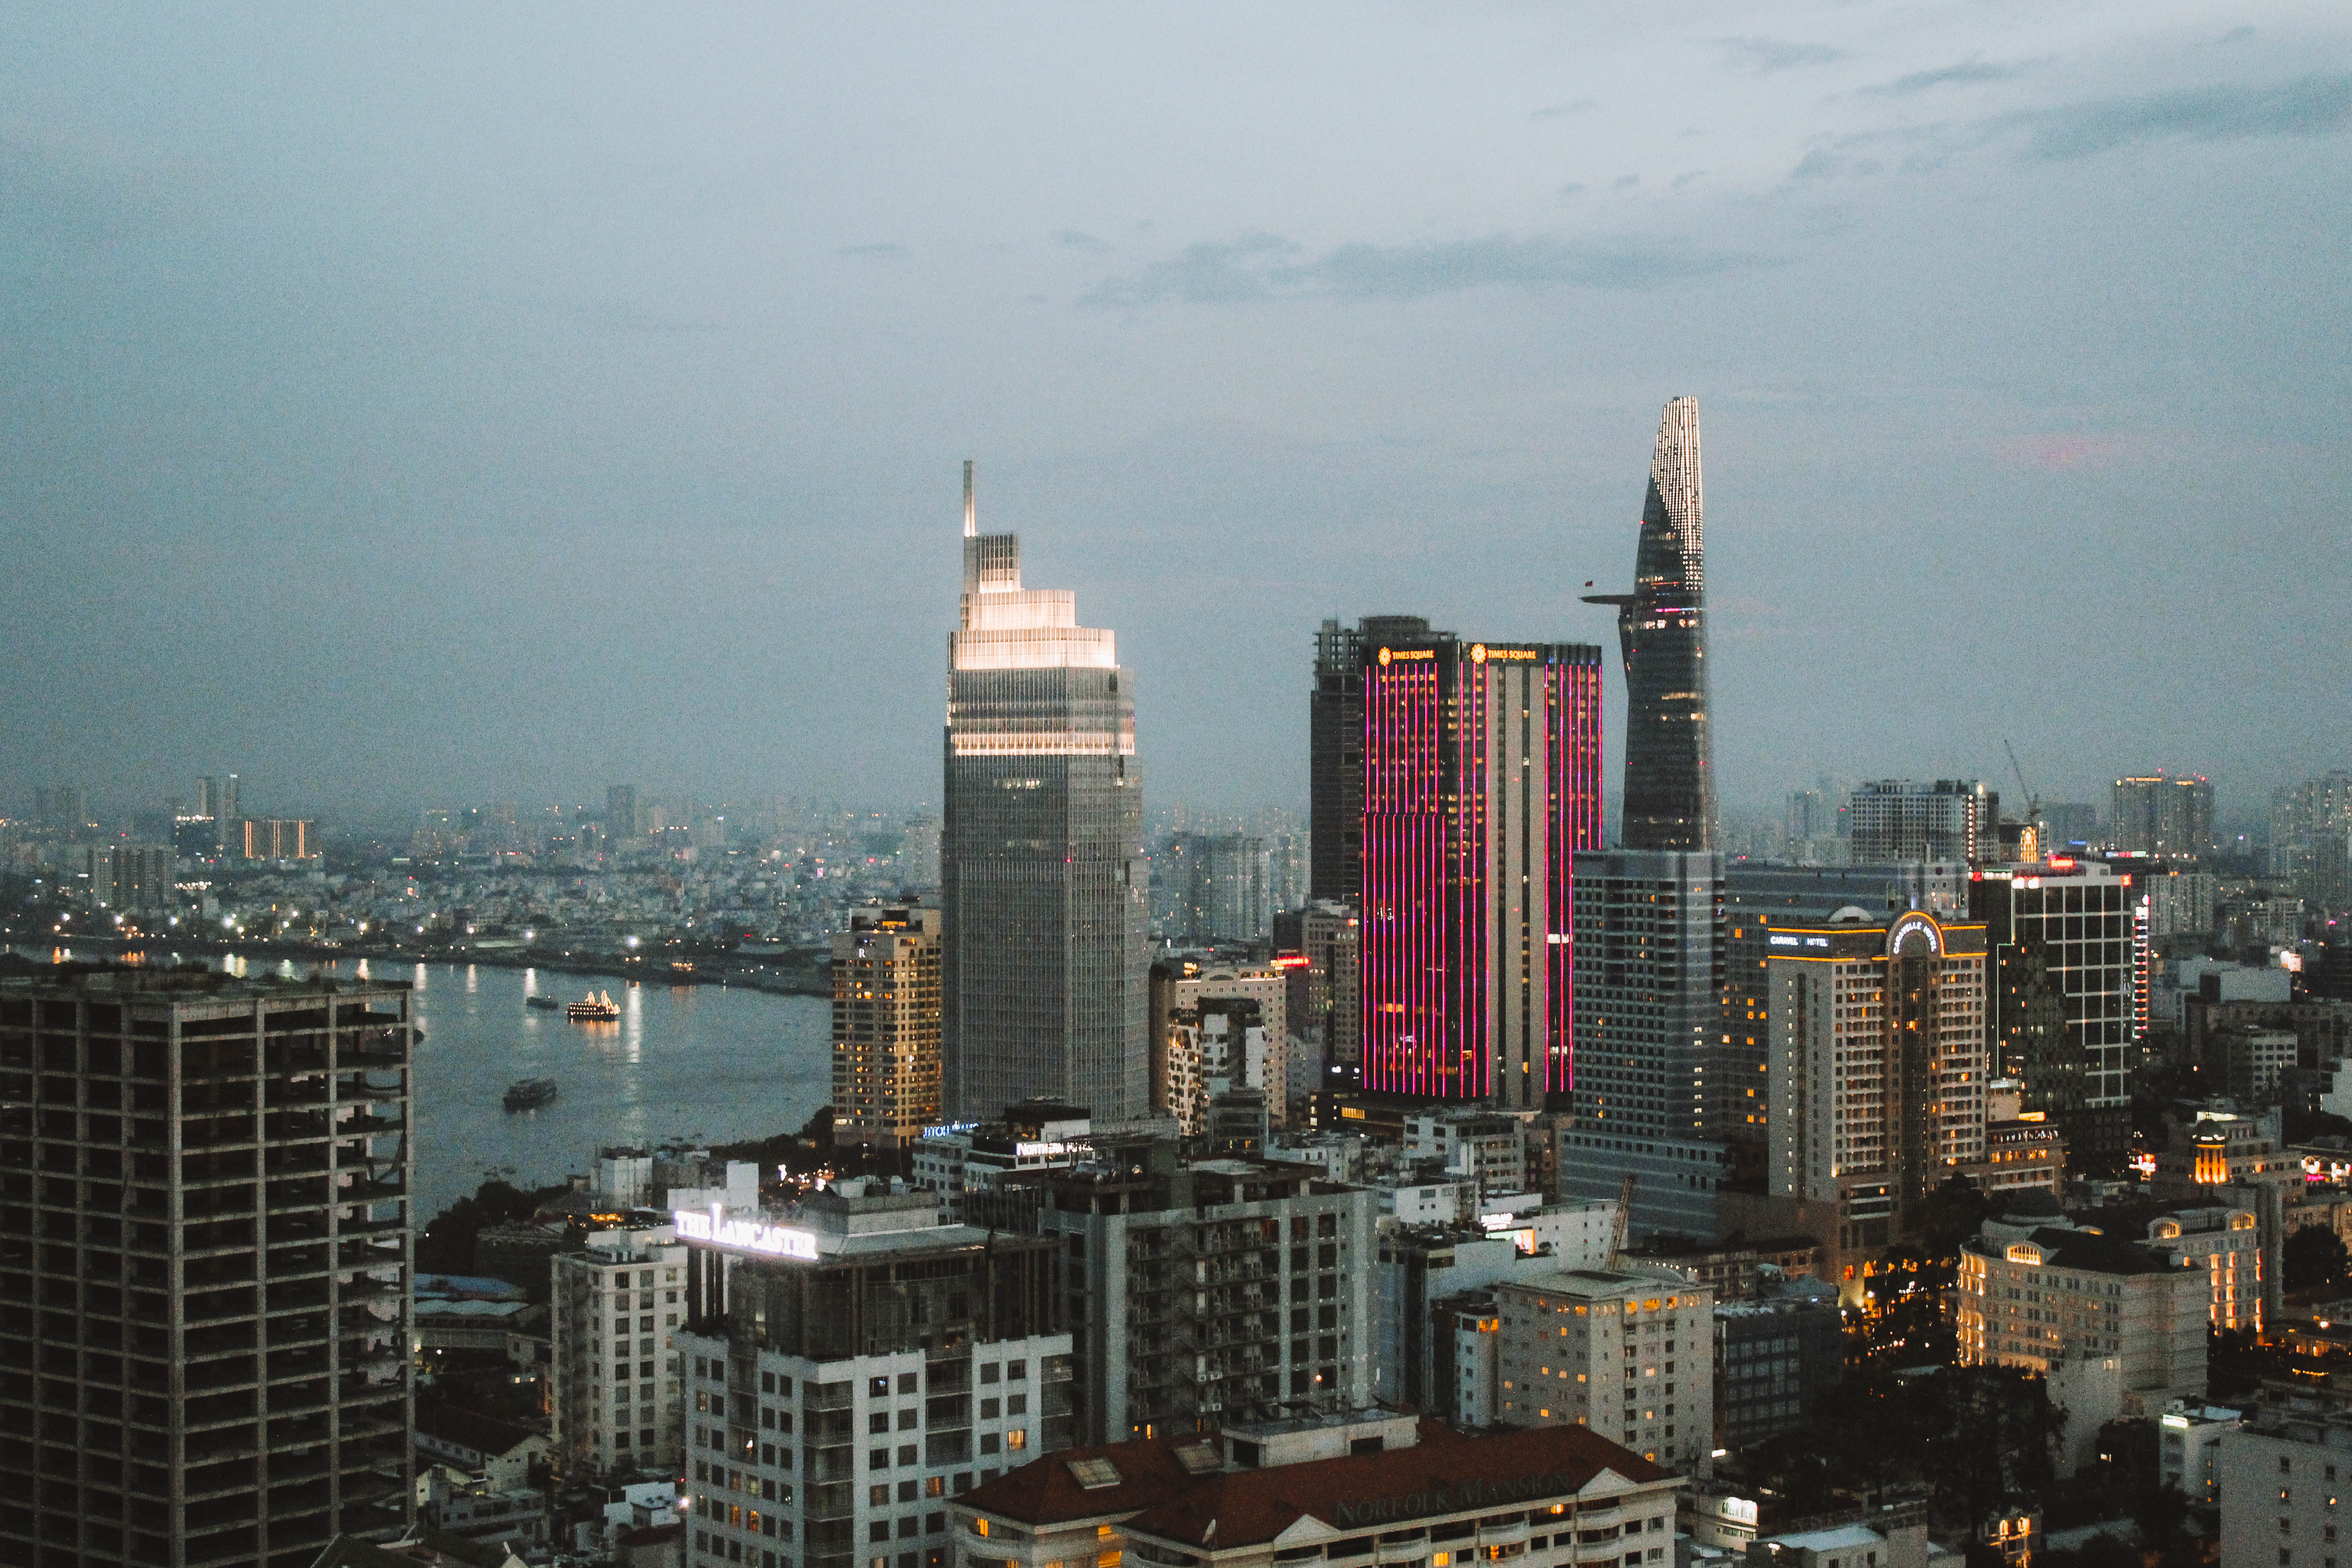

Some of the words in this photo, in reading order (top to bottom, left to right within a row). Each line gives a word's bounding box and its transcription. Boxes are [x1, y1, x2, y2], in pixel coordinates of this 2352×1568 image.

[1392, 651, 1410, 660] TIMES
[1410, 650, 1434, 660] SQUARE
[1488, 650, 1508, 659] TIMES
[1509, 650, 1537, 660] SQUARE
[1807, 937, 1828, 947] HOTEL
[1893, 921, 1922, 955] CARAVELLE
[1923, 925, 1937, 952] HOTEL
[859, 948, 866, 958] R
[1016, 1143, 1064, 1156] NORTHERN
[675, 1211, 711, 1240] THE
[712, 1202, 818, 1259] LANCASTER
[1336, 1489, 1453, 1525] NORFOLK
[1459, 1473, 1569, 1505] MANSION
